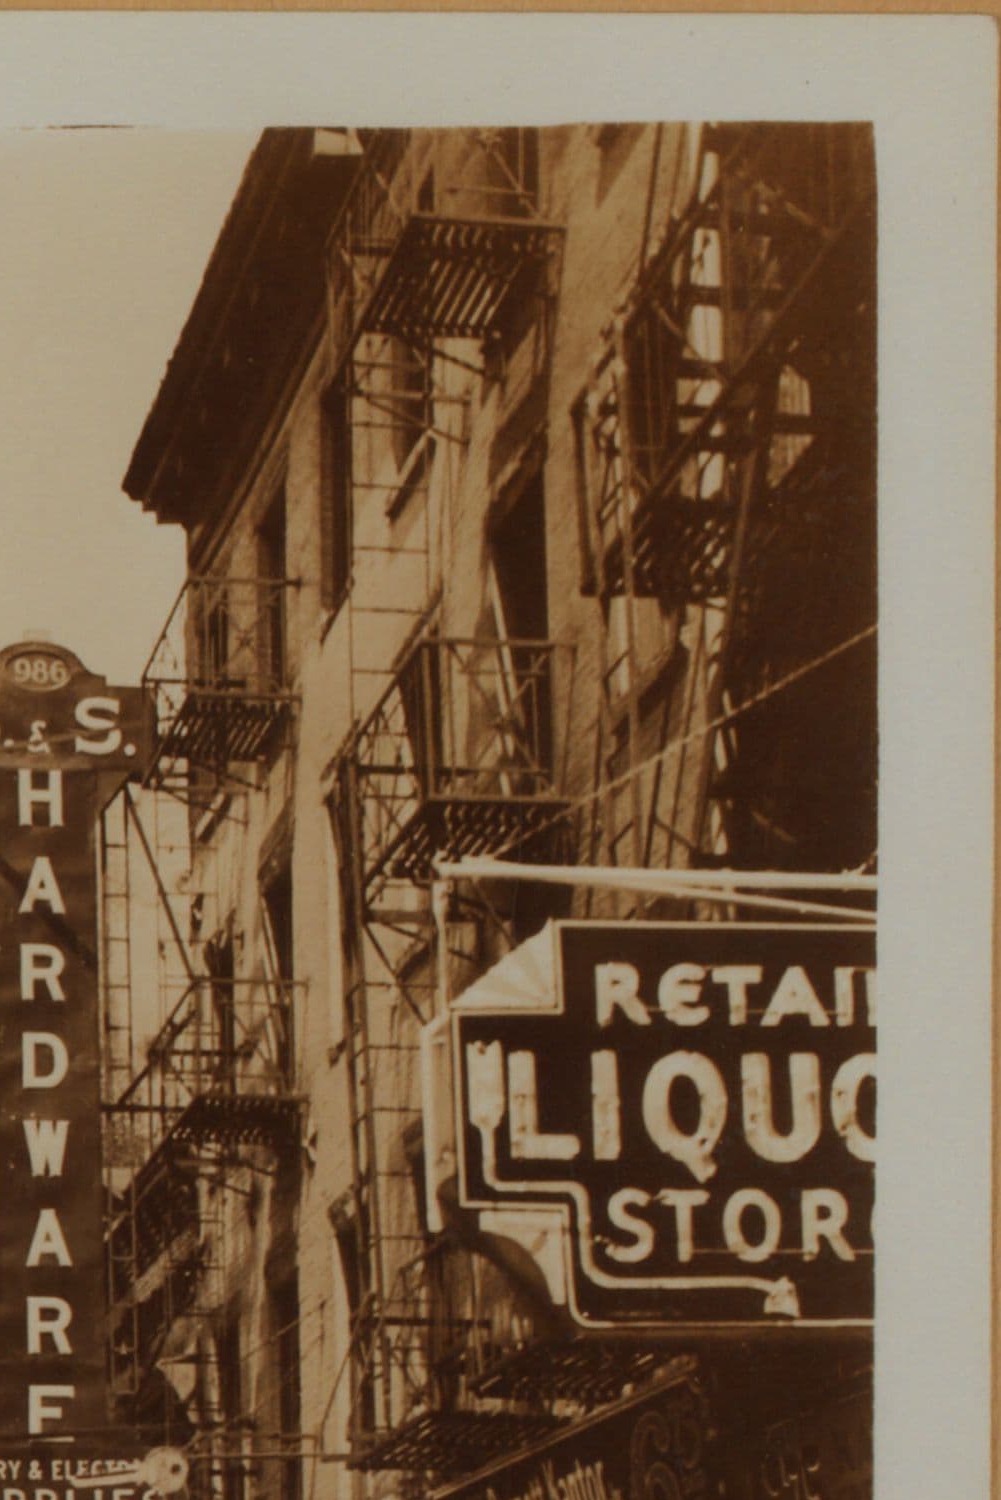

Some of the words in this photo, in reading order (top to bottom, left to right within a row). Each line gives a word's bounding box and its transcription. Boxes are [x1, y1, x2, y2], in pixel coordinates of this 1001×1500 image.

[13, 658, 68, 682] 986
[27, 720, 51, 754] &
[74, 697, 137, 758] S.
[604, 1187, 876, 1263] STOR
[28, 1459, 43, 1481] &
